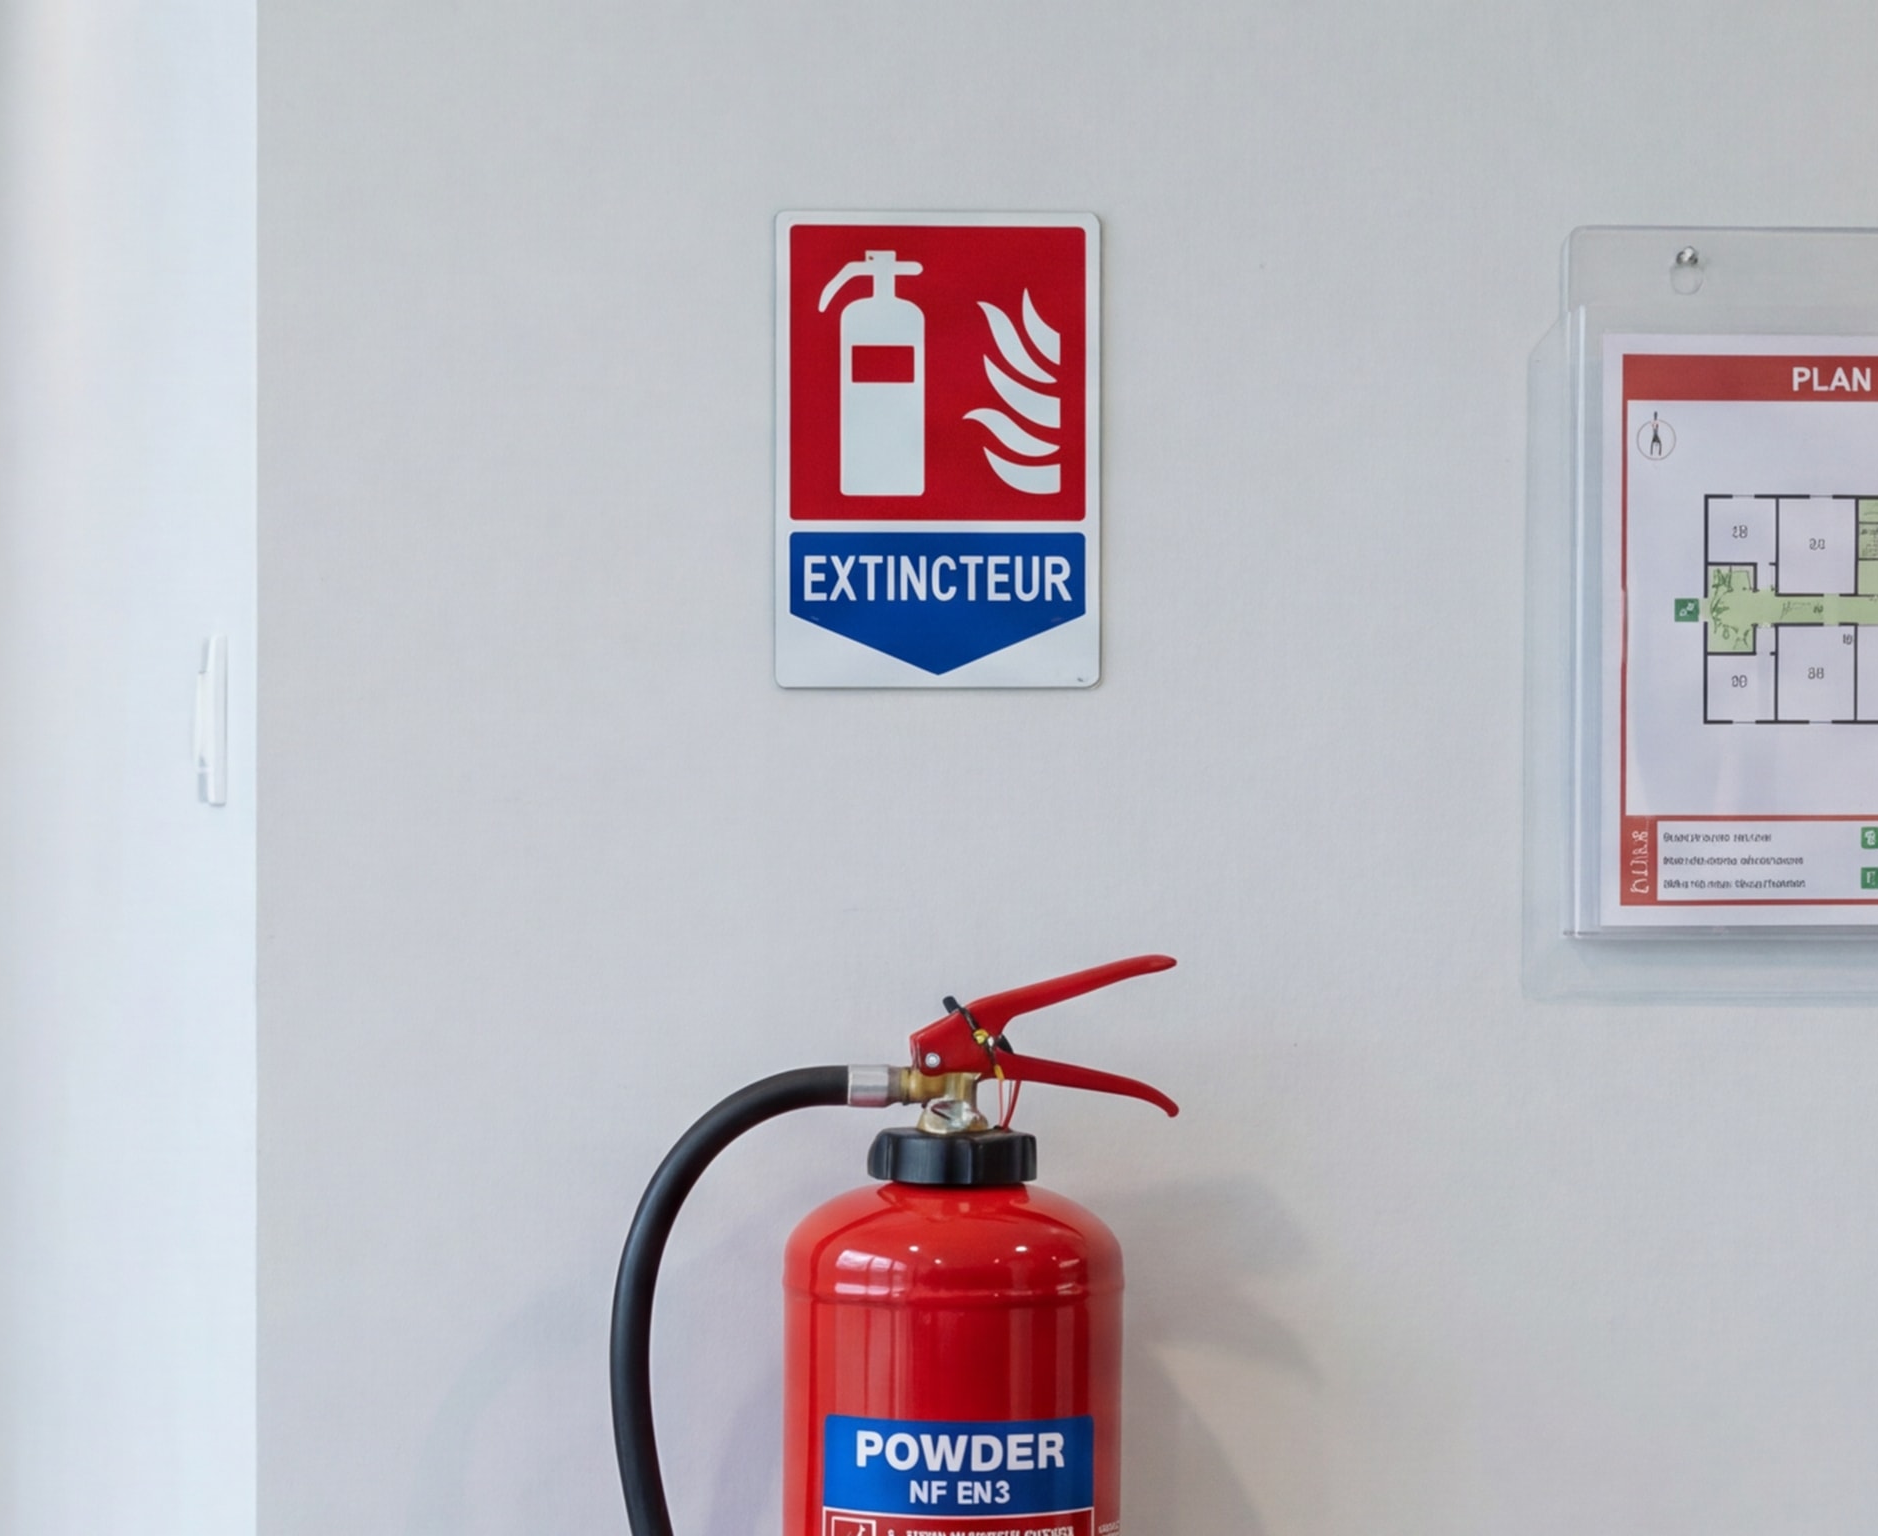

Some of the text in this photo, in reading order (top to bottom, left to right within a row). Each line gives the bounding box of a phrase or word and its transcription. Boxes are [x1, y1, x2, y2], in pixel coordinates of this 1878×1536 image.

[1792, 367, 1871, 392] PLAN
[803, 555, 1073, 602] EXTINCTEUR
[856, 1430, 1065, 1472] POWDER
[909, 1480, 947, 1505] NF
